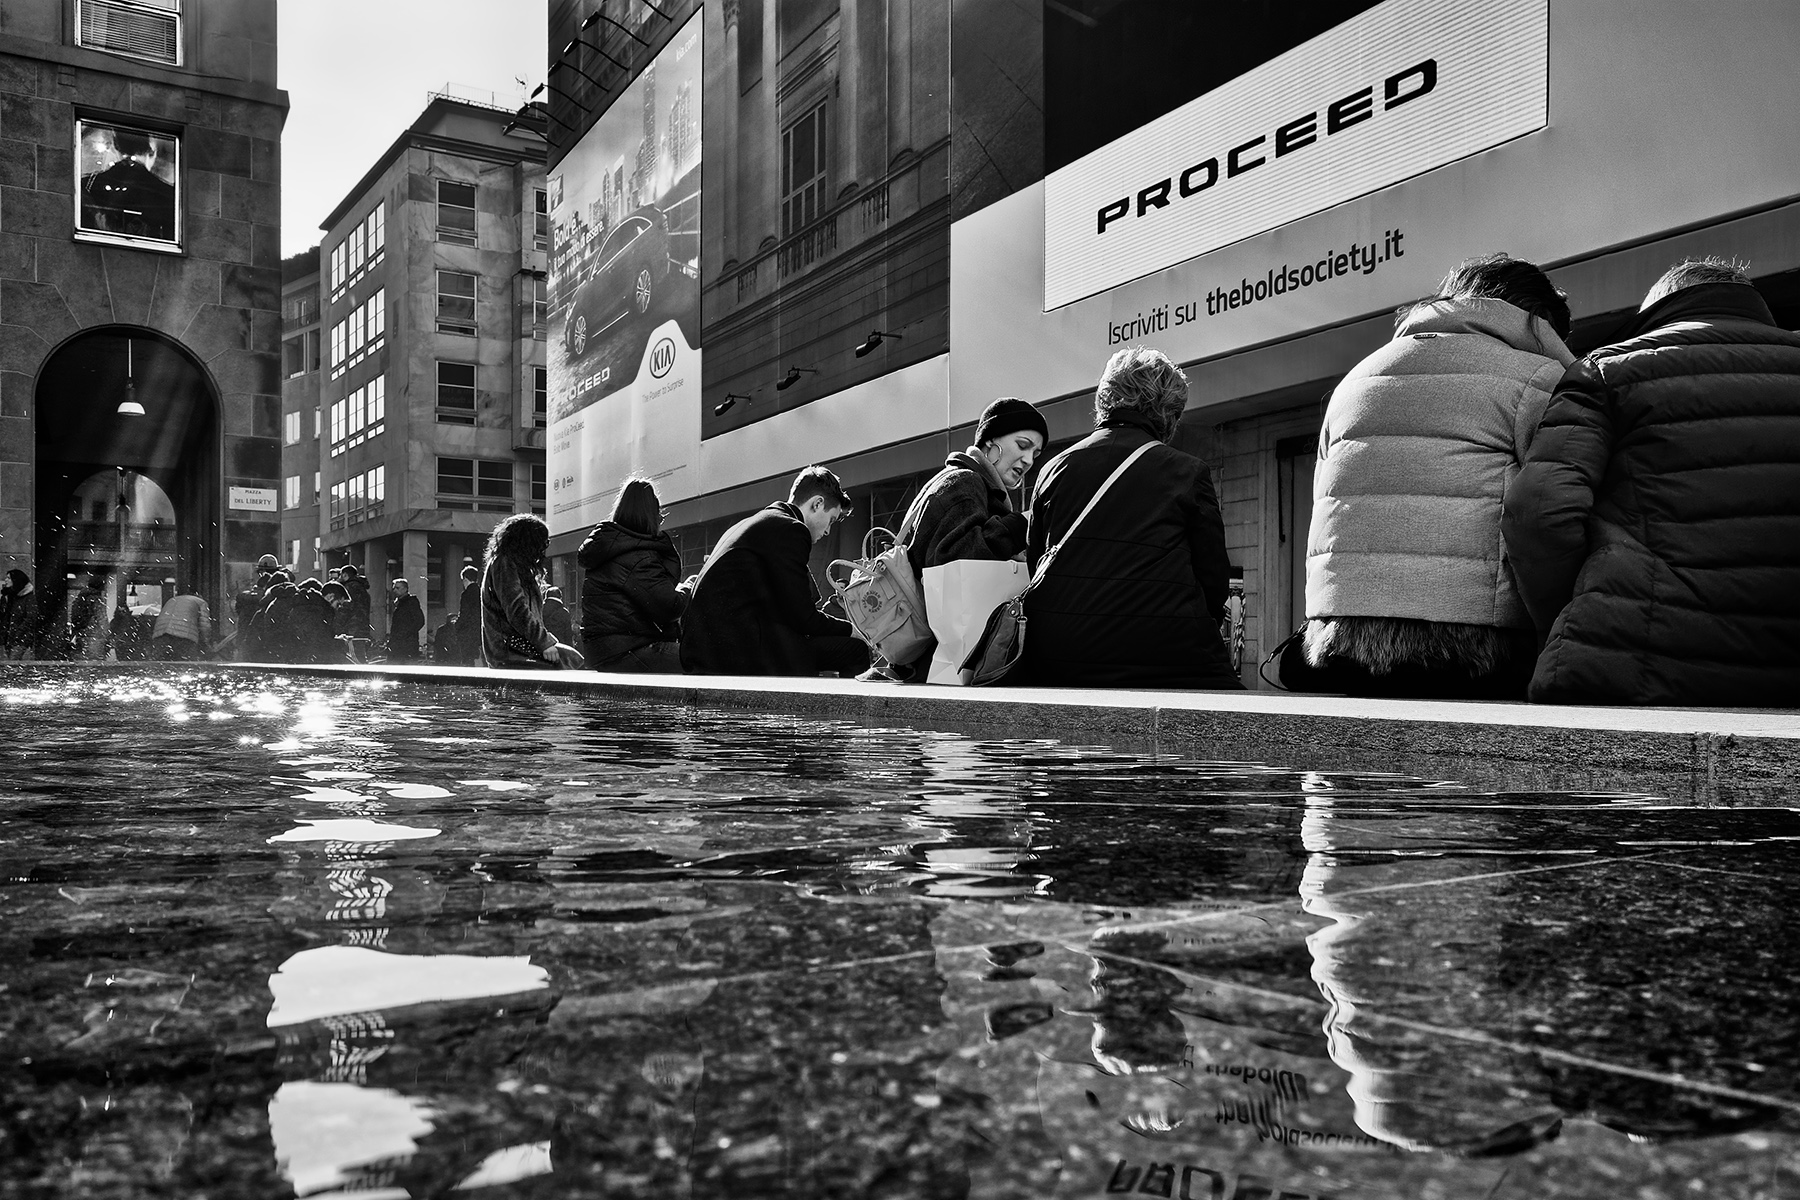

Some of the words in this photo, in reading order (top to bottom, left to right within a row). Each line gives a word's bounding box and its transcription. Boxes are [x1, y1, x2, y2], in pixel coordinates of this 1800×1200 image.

[1097, 58, 1438, 235] PROCEED
[1108, 303, 1169, 346] Iscriviti
[1175, 299, 1197, 326] su
[1205, 227, 1405, 317] theboldsociety.it
[653, 344, 671, 373] KIA
